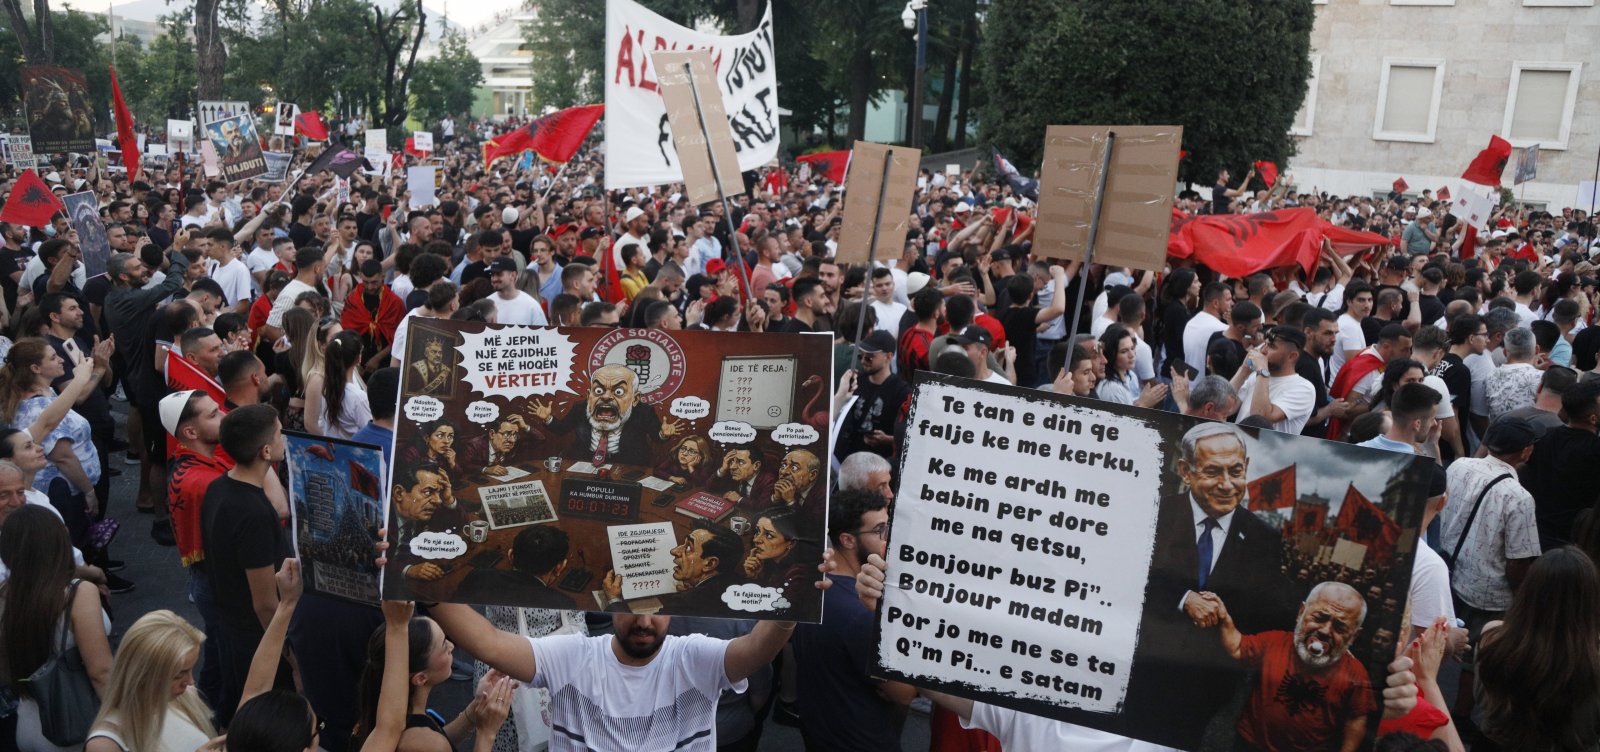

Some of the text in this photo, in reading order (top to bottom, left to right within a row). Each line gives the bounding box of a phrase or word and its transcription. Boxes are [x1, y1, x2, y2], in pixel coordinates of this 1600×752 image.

[727, 87, 776, 152] ALE
[226, 158, 263, 175] HAJDUTI
[476, 347, 557, 359] NJË ZGJIDHJE
[484, 335, 539, 346] MË JEPNI
[592, 329, 681, 376] PARTIA SOCIALISTE
[478, 358, 558, 371] SE MË HOQËN
[485, 372, 557, 388] VËRTET!
[748, 364, 759, 372] TË
[942, 395, 1120, 442] Te tan e din qe
[919, 420, 1140, 477] falje ke me kerku,
[928, 457, 1110, 508] Ke me ardh me
[920, 484, 1109, 536] babin per dore
[931, 517, 1087, 565] me na qetsu,
[632, 580, 660, 590] ?????
[899, 544, 1002, 581] Bonjour
[1010, 568, 1056, 594] buz
[899, 572, 1103, 636] Bonjour madam
[887, 606, 1116, 676] Por jo me ne se ta
[951, 650, 991, 676] Pi...
[1000, 664, 1013, 679] e
[1021, 668, 1103, 701] satam
